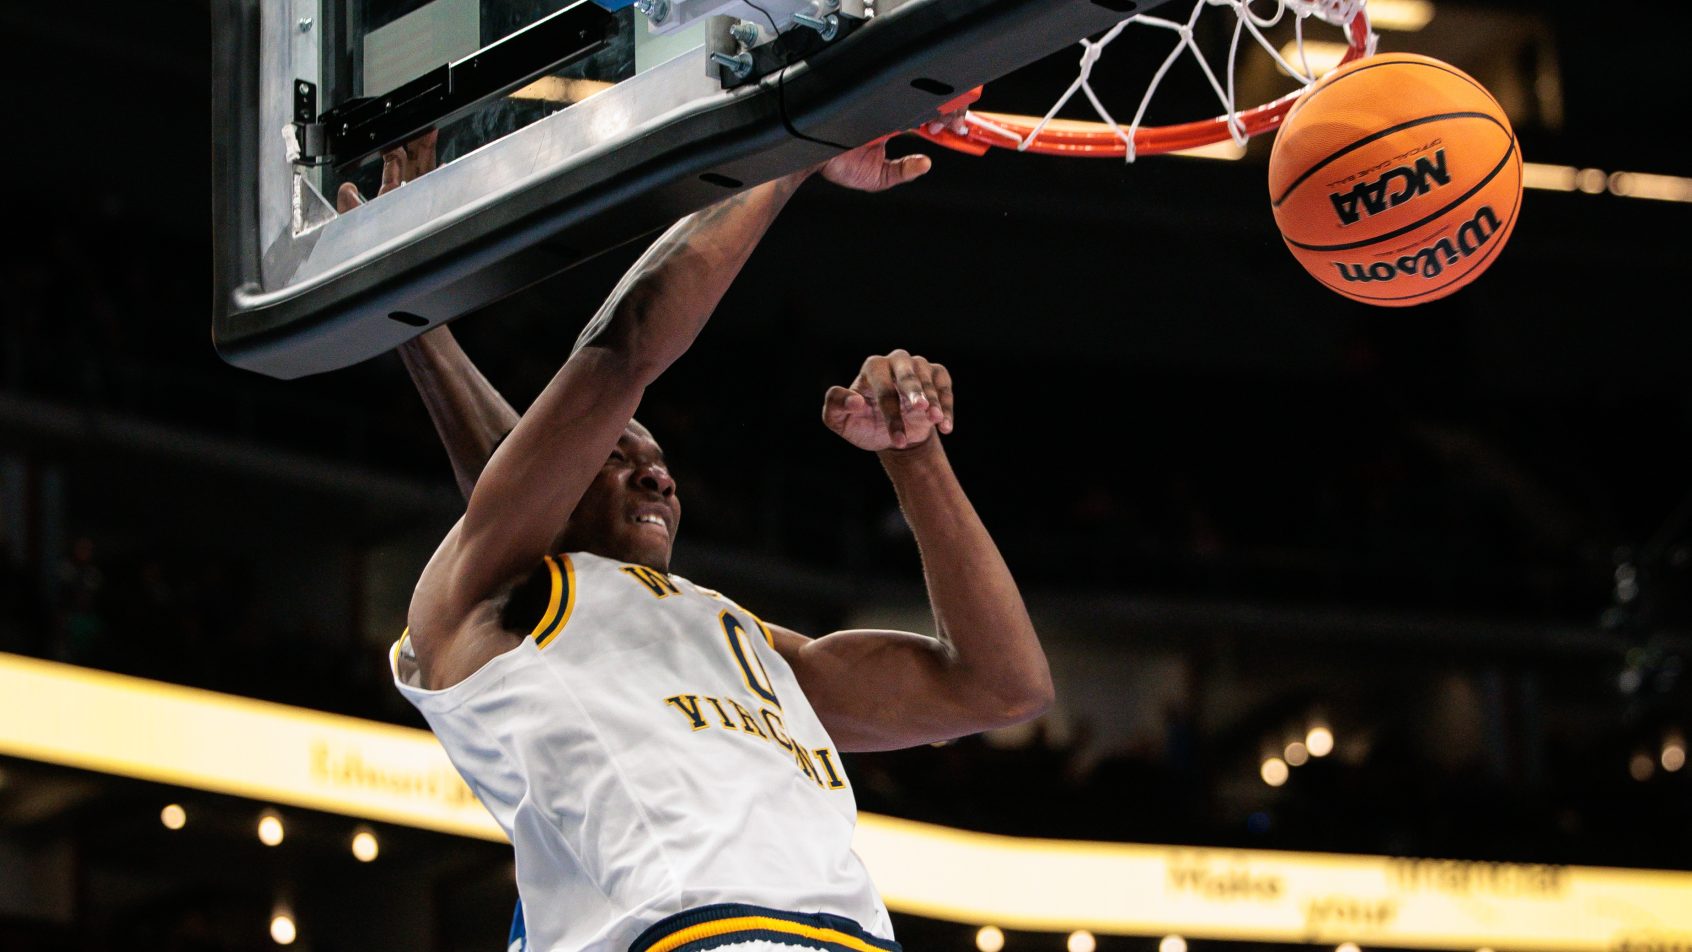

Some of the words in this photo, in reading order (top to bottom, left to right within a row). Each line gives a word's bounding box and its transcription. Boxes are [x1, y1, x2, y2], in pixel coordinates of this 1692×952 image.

[1329, 149, 1452, 226] NCAA
[1333, 204, 1502, 283] Wilson
[663, 694, 847, 791] VIRGNI
